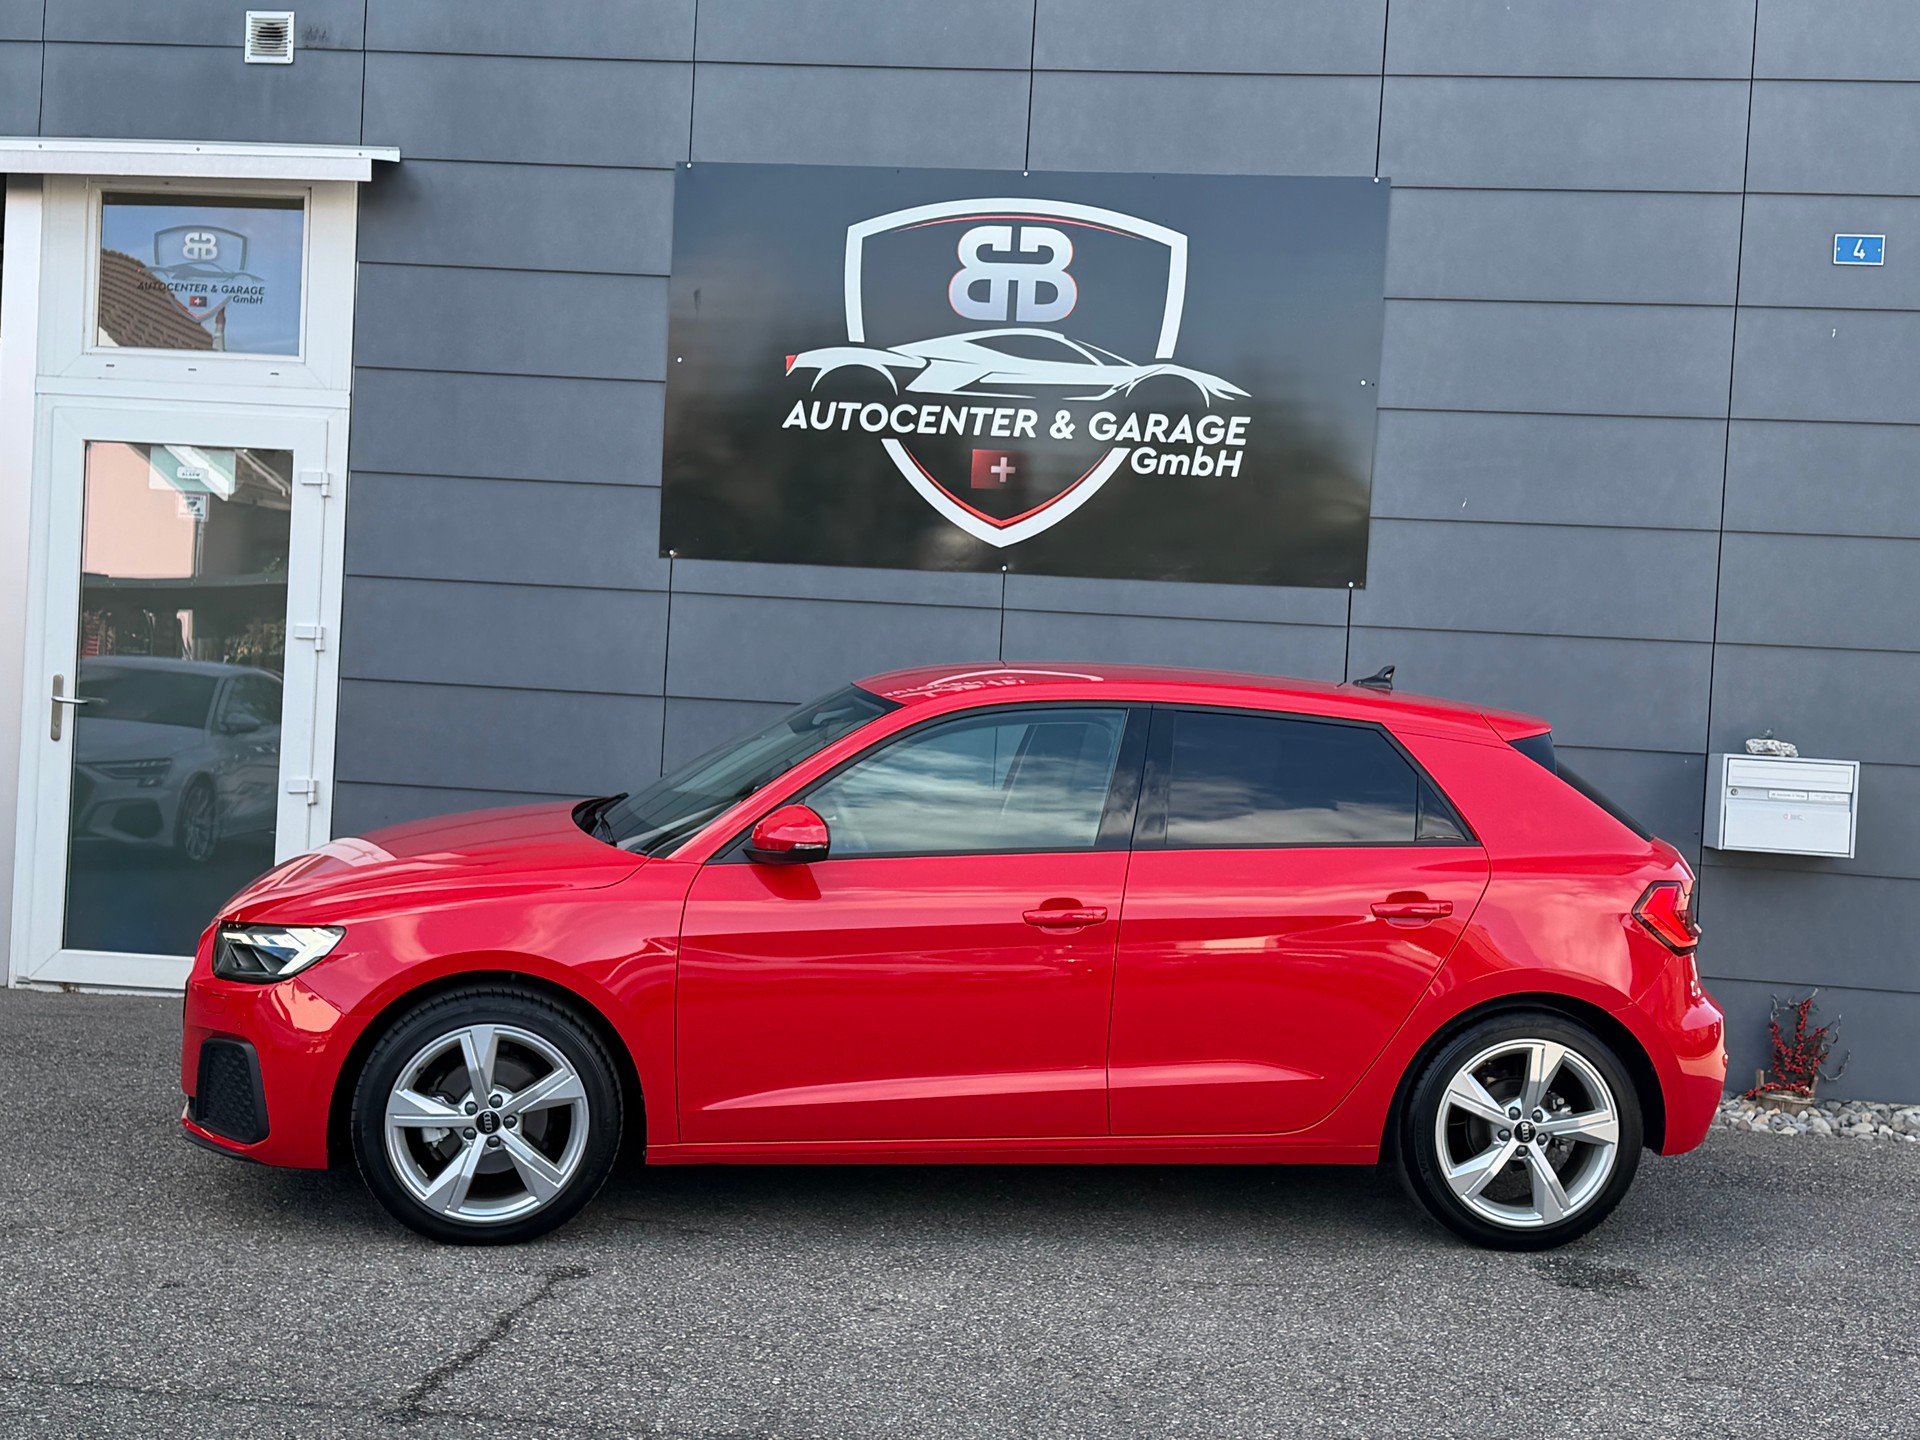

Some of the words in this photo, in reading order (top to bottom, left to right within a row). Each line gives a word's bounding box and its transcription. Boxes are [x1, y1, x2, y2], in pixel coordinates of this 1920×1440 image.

[1853, 239, 1866, 259] 4
[136, 281, 209, 293] AUTOCENTER
[210, 284, 218, 293] &
[221, 285, 265, 296] GARAGE
[232, 294, 264, 305] GmbH
[782, 399, 1039, 438] AUTOCENTER
[1049, 410, 1076, 440] &
[1088, 411, 1252, 446] GARAGE
[1130, 446, 1244, 478] GmbH
